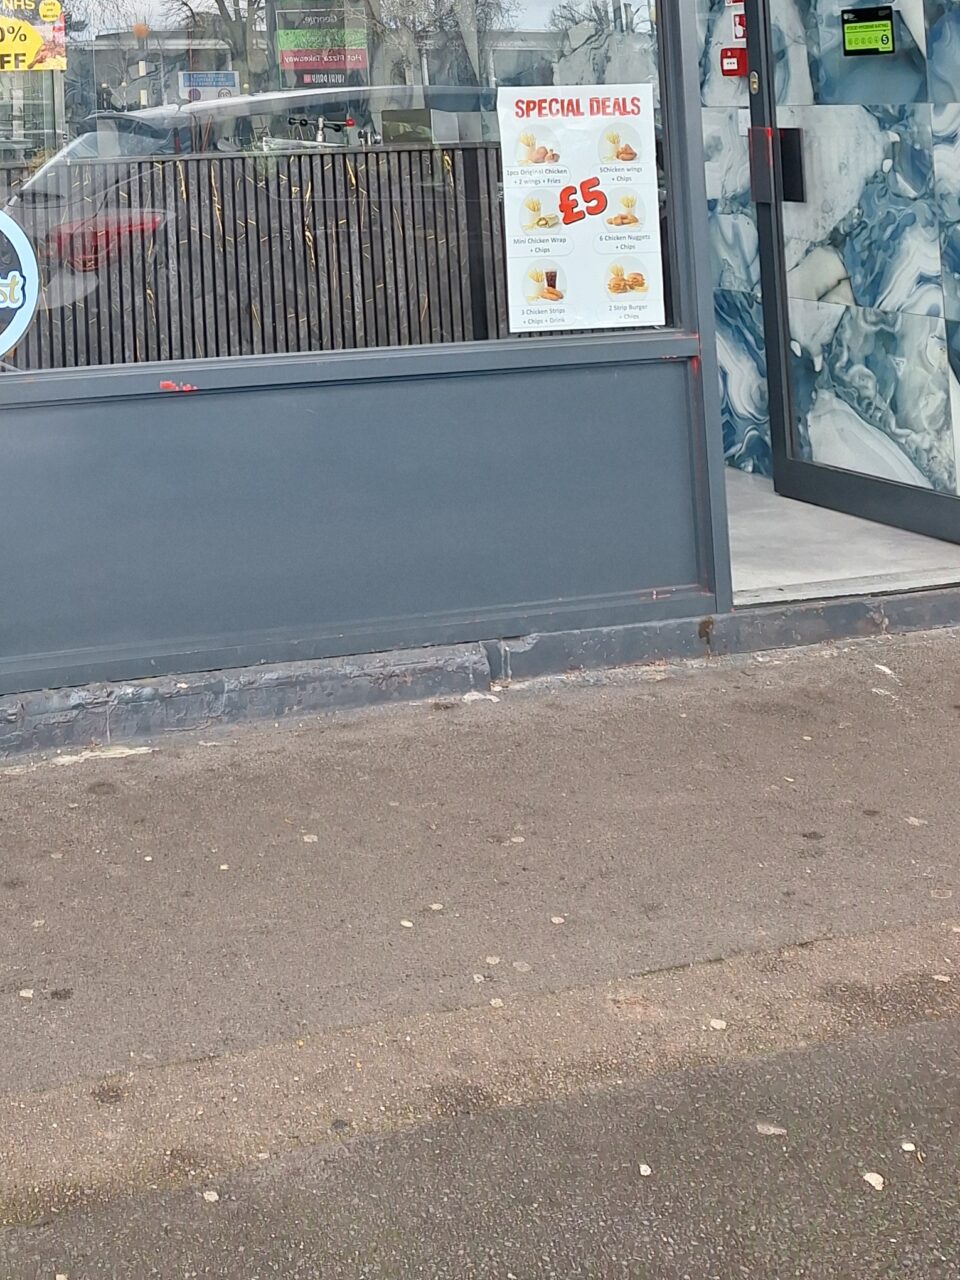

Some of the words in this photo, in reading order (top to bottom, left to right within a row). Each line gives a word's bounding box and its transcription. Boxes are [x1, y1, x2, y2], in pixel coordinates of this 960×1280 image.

[515, 98, 584, 118] SPECIAL
[589, 96, 641, 117] DEALS
[520, 169, 543, 177] Original
[559, 177, 608, 225] £5
[549, 307, 566, 315] Strips
